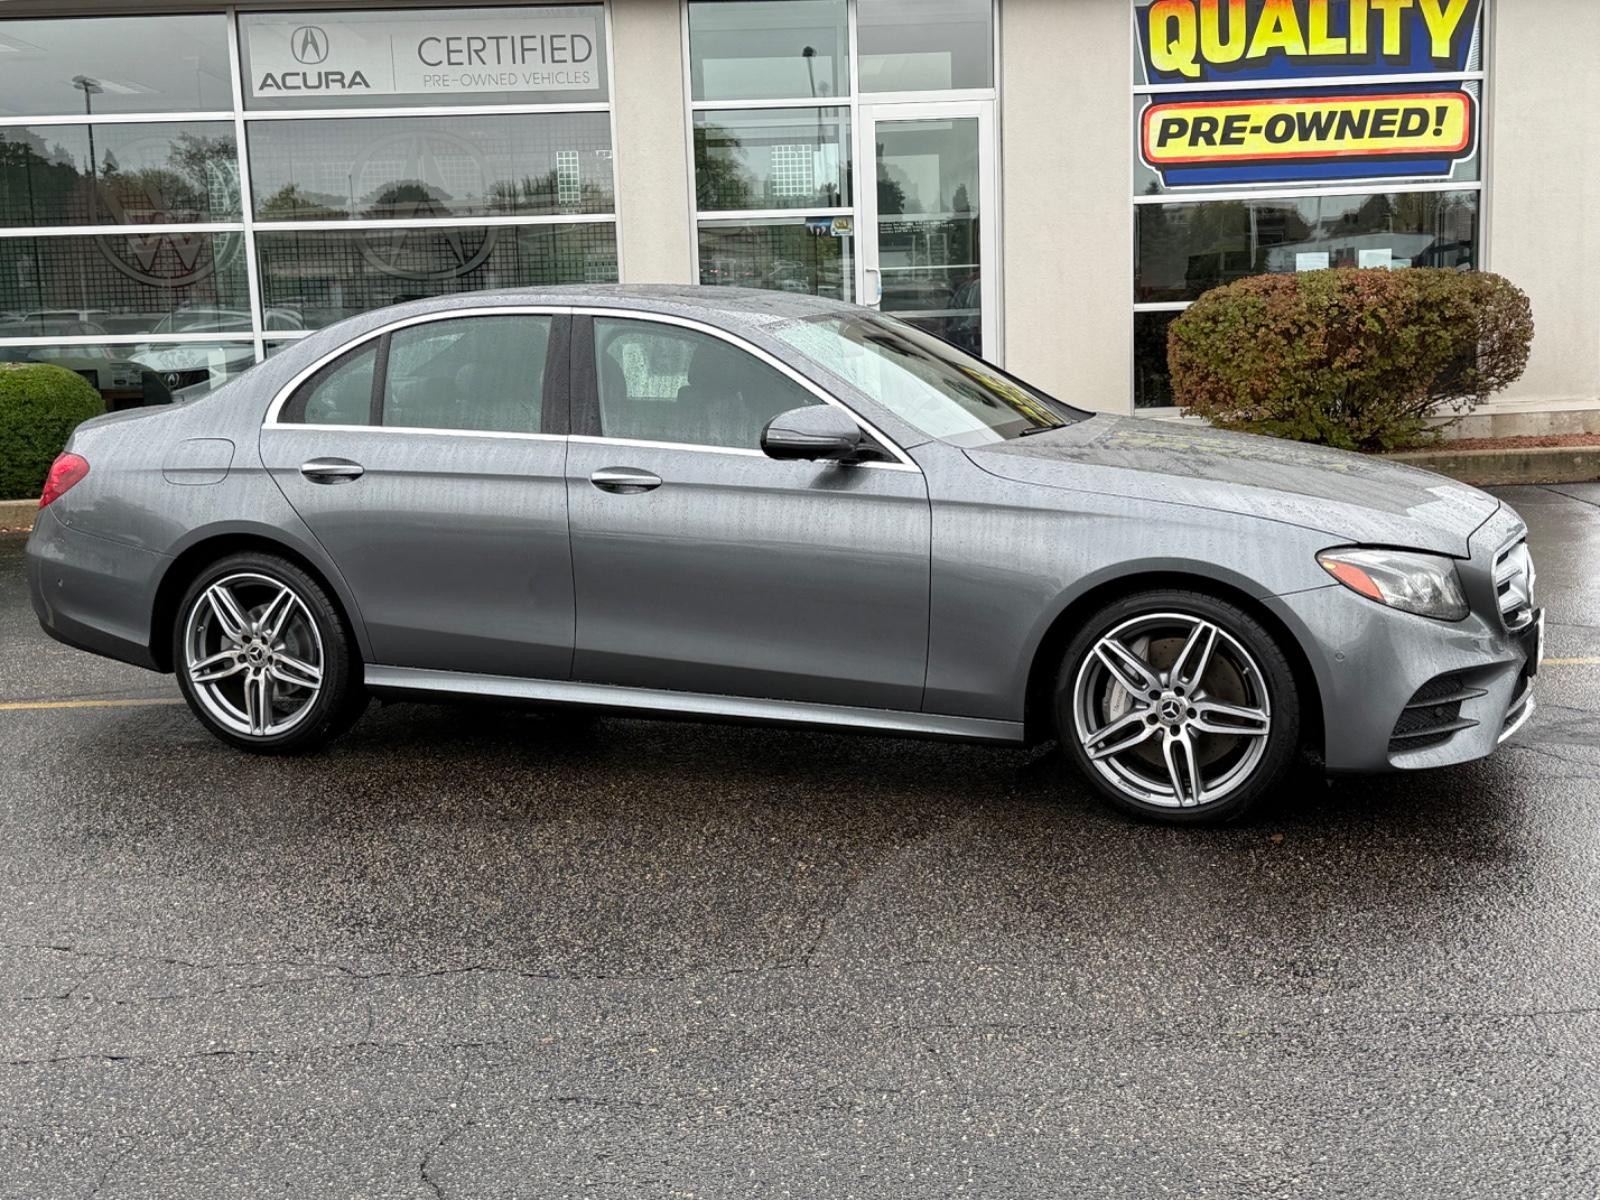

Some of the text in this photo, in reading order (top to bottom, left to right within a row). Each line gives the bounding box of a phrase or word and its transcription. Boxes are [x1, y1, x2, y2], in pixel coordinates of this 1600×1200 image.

[417, 34, 593, 67] CERTIFIED
[1149, 0, 1469, 77] QUALITY
[258, 70, 371, 91] ACURA
[423, 71, 591, 88] PRE-OWNED VEHICLES
[1156, 106, 1449, 148] PRE-OWNED!
